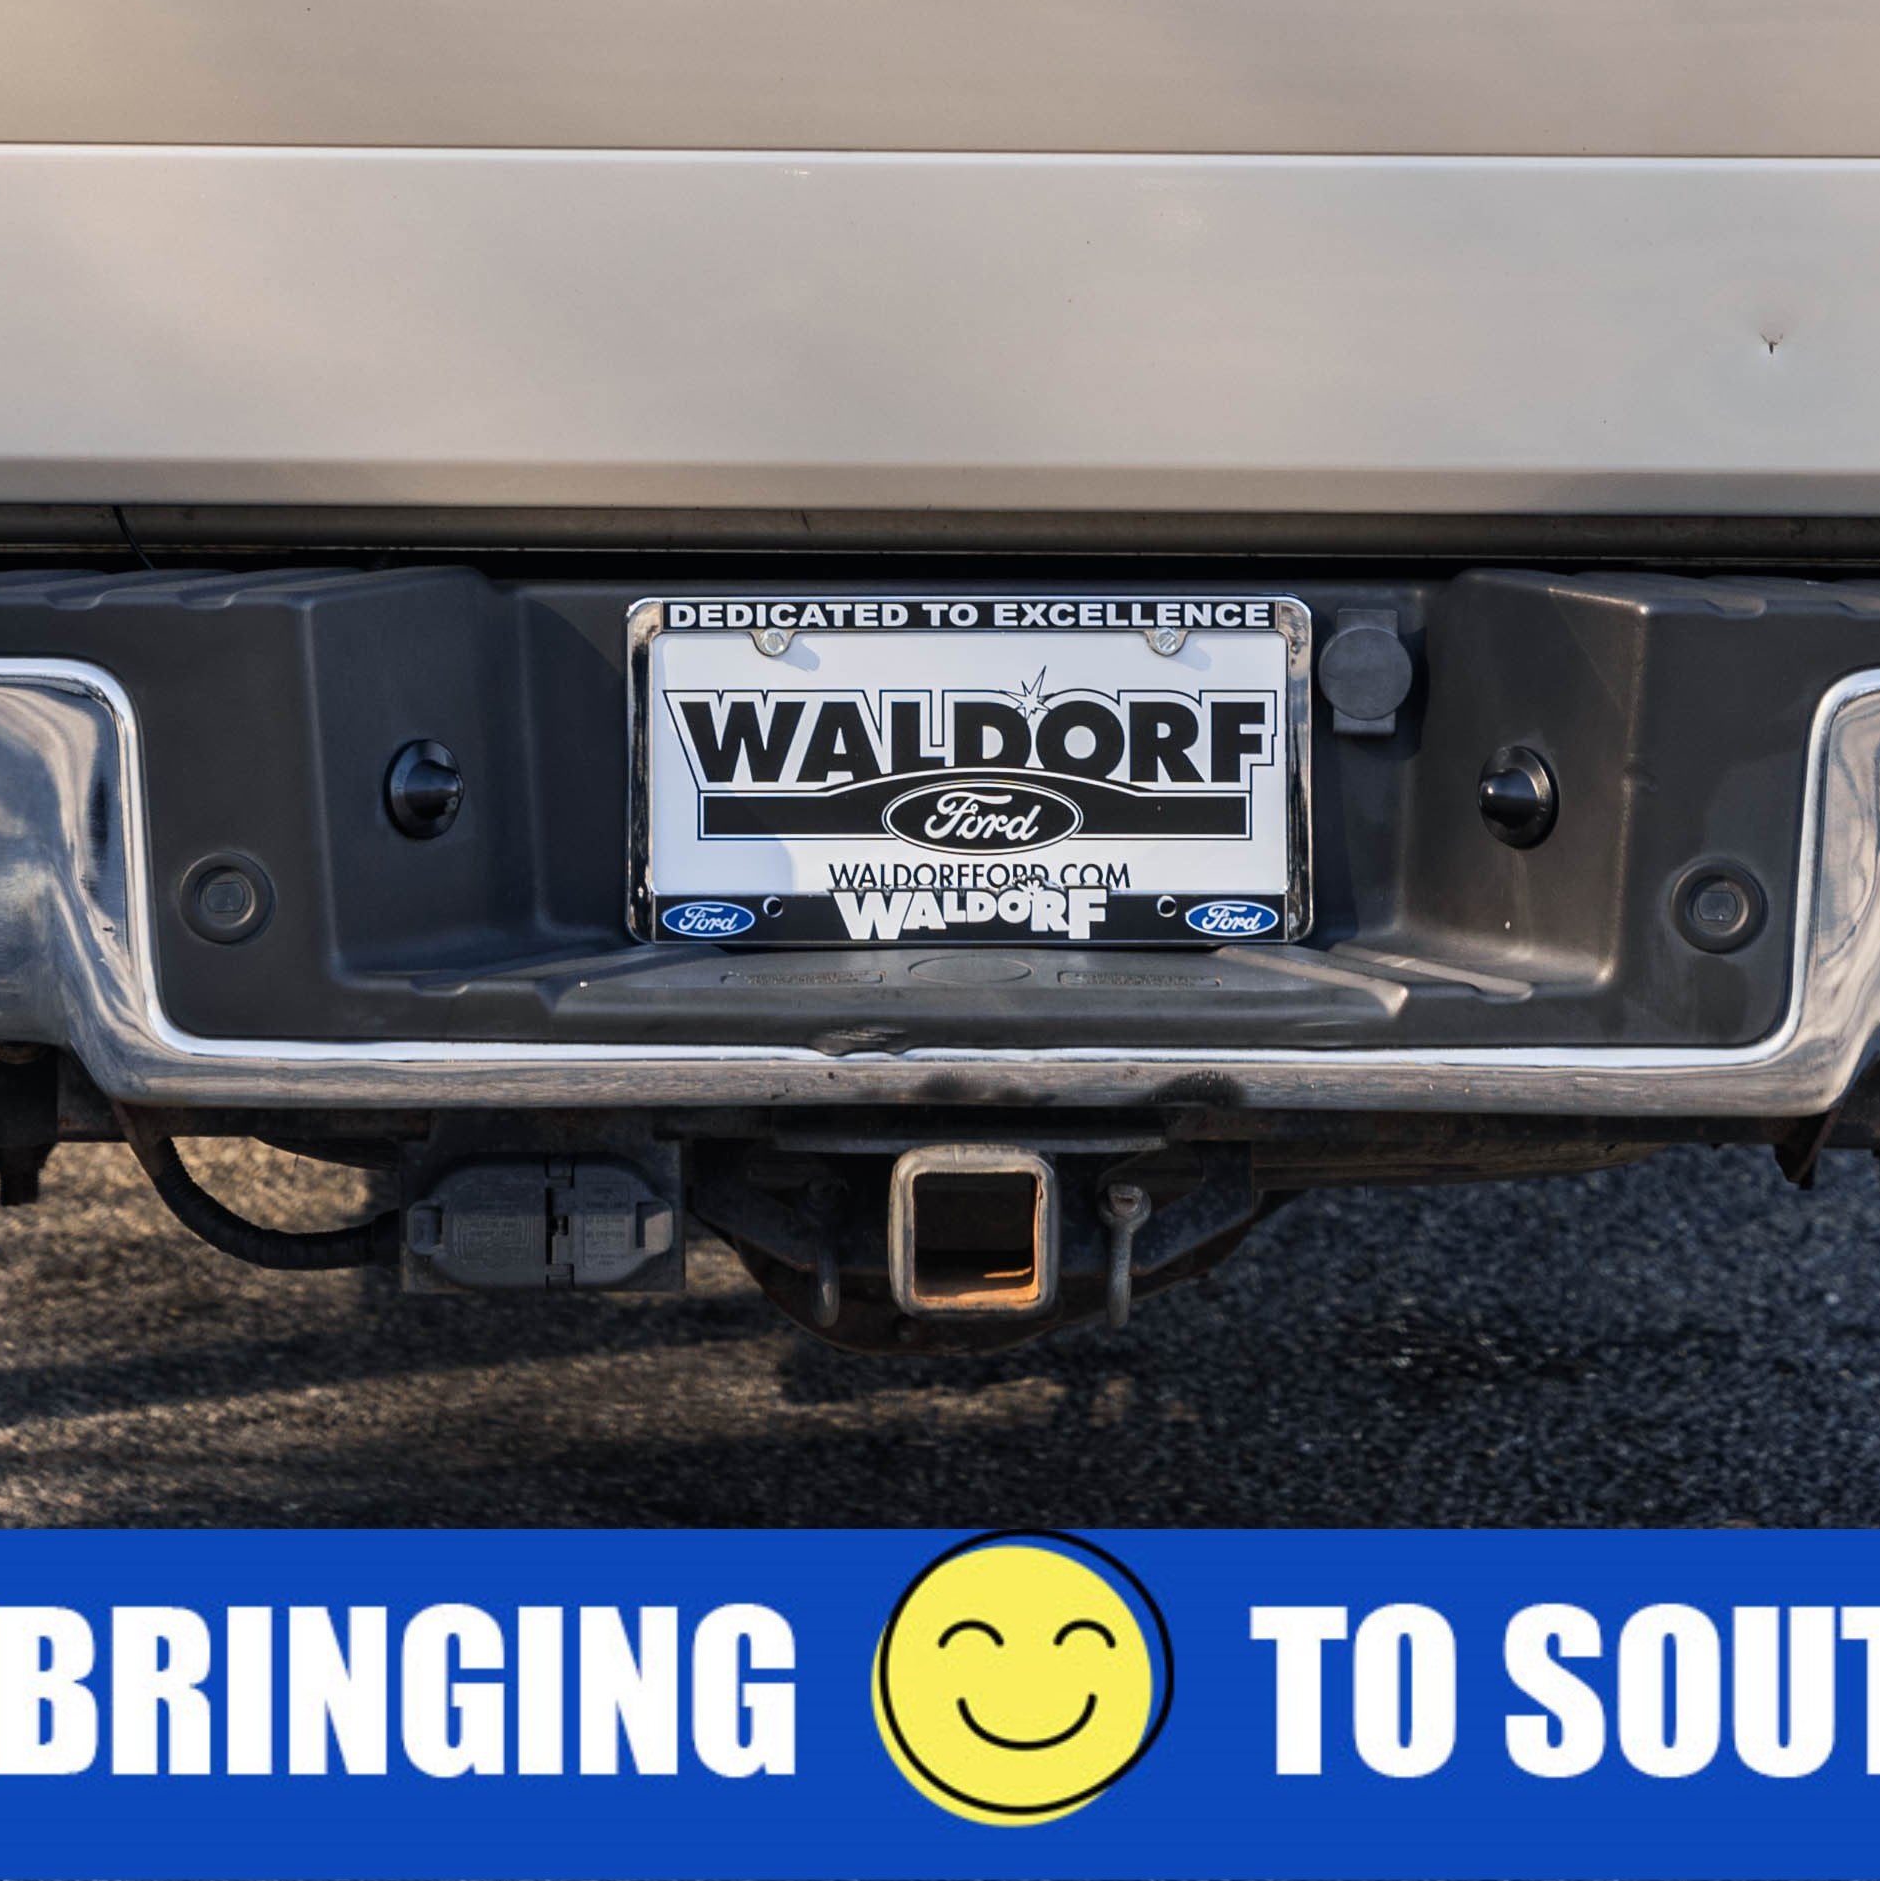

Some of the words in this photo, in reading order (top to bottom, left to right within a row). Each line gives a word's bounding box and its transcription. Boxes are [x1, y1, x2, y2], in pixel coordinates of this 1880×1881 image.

[669, 603, 912, 628] DEDICATED
[922, 603, 980, 628] TO
[993, 603, 1271, 628] EXCELLENCE
[680, 699, 1270, 783] WALDORF
[923, 791, 1041, 840] Ford
[828, 863, 1131, 888] WALDORFFORDCOM
[679, 906, 739, 931] Ford
[1202, 905, 1262, 930] Ford
